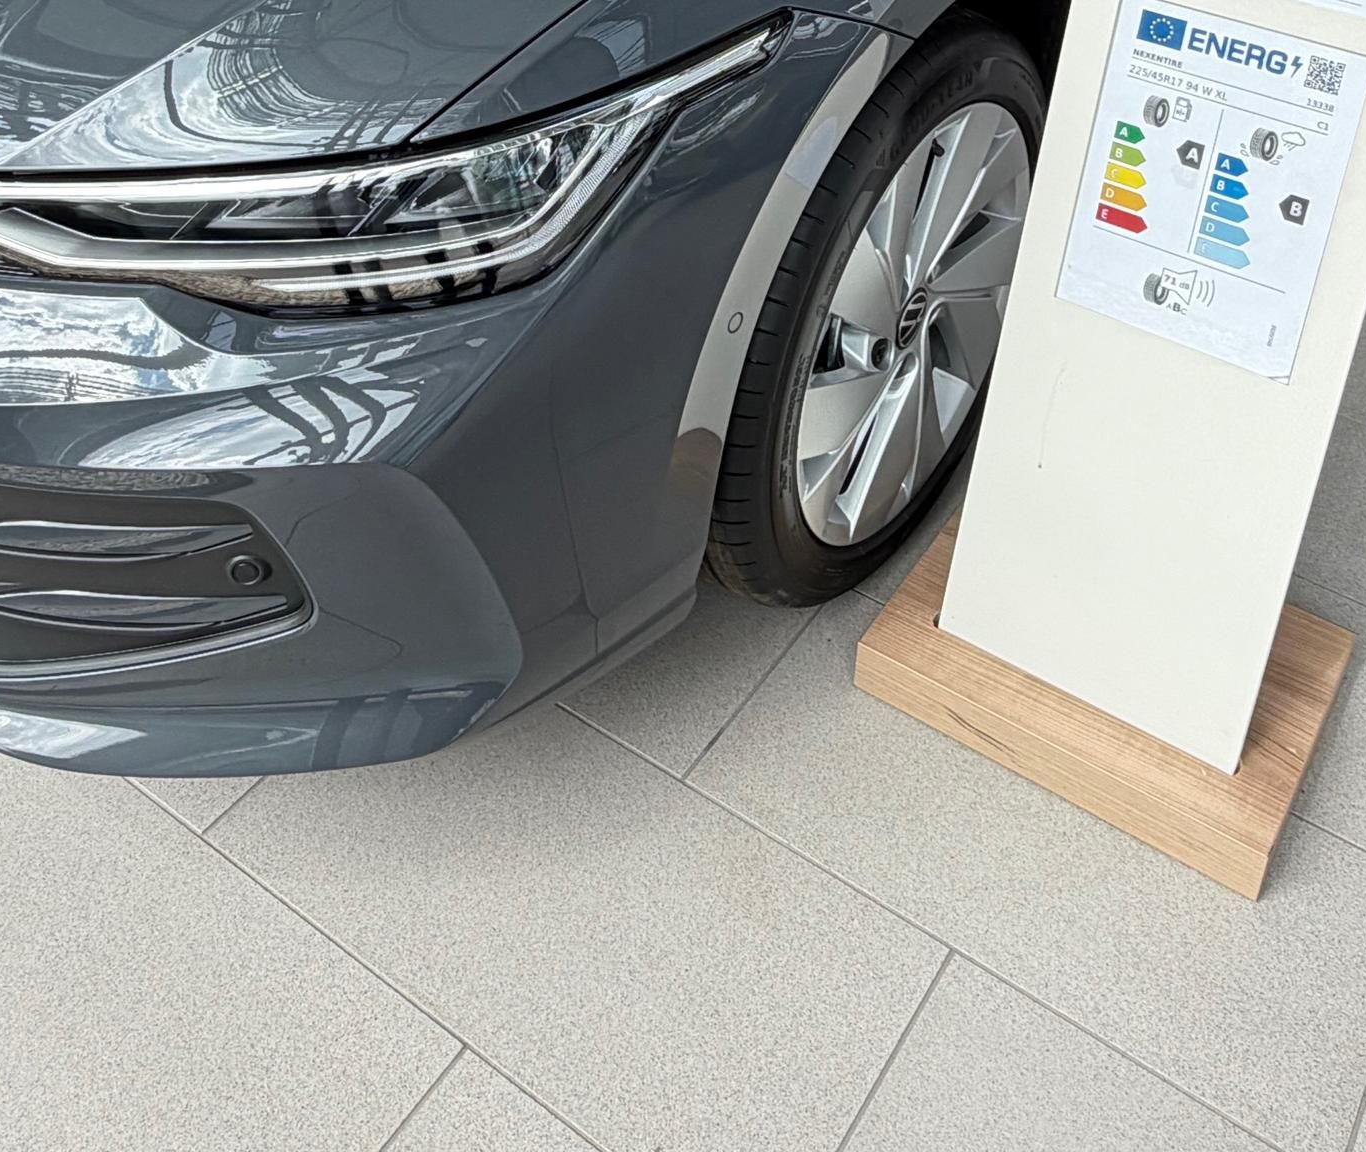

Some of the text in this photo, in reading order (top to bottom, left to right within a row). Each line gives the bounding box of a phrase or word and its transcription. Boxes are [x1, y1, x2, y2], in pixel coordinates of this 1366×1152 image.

[1187, 27, 1289, 75] ENERG
[1132, 47, 1183, 69] NEXENTIRE
[1128, 64, 1228, 101] 225/45R17 94 W XL
[1316, 120, 1329, 132] C1
[1119, 127, 1128, 137] A
[1114, 148, 1123, 158] B
[1185, 148, 1199, 164] A
[1220, 159, 1231, 170] A
[1110, 169, 1118, 179] C
[1216, 180, 1225, 191] B
[1105, 189, 1115, 199] D
[1210, 201, 1219, 213] C
[1290, 202, 1303, 217] B
[1101, 209, 1109, 219] E
[1205, 222, 1215, 233] D
[1164, 274, 1190, 290] 71 dB
